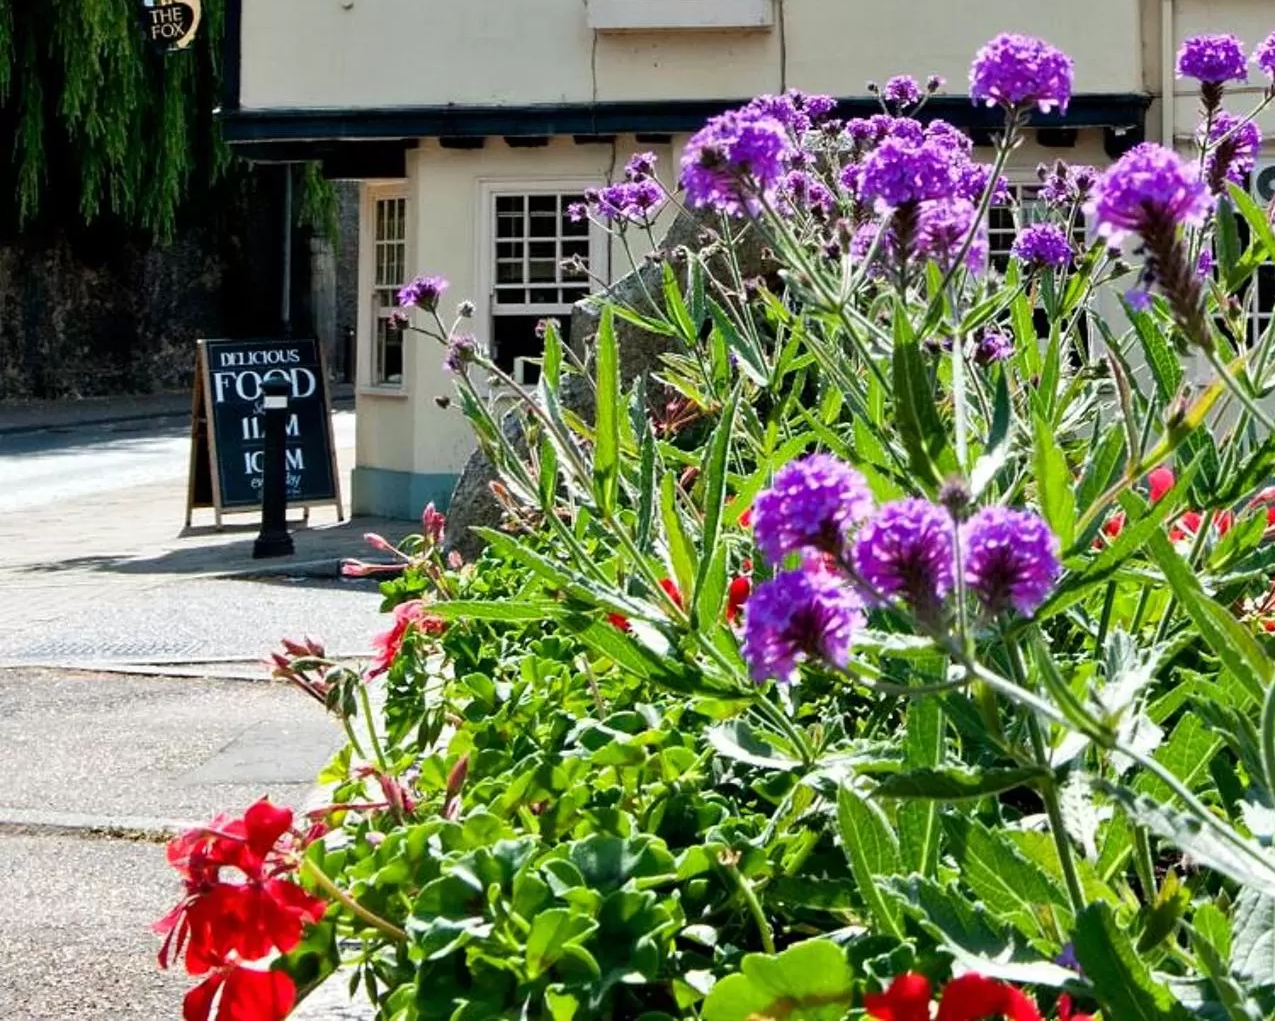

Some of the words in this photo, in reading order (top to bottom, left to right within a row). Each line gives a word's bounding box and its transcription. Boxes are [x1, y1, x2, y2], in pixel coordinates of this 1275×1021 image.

[150, 7, 183, 24] THE
[152, 23, 185, 40] FOX
[220, 349, 300, 366] DELICIOUS
